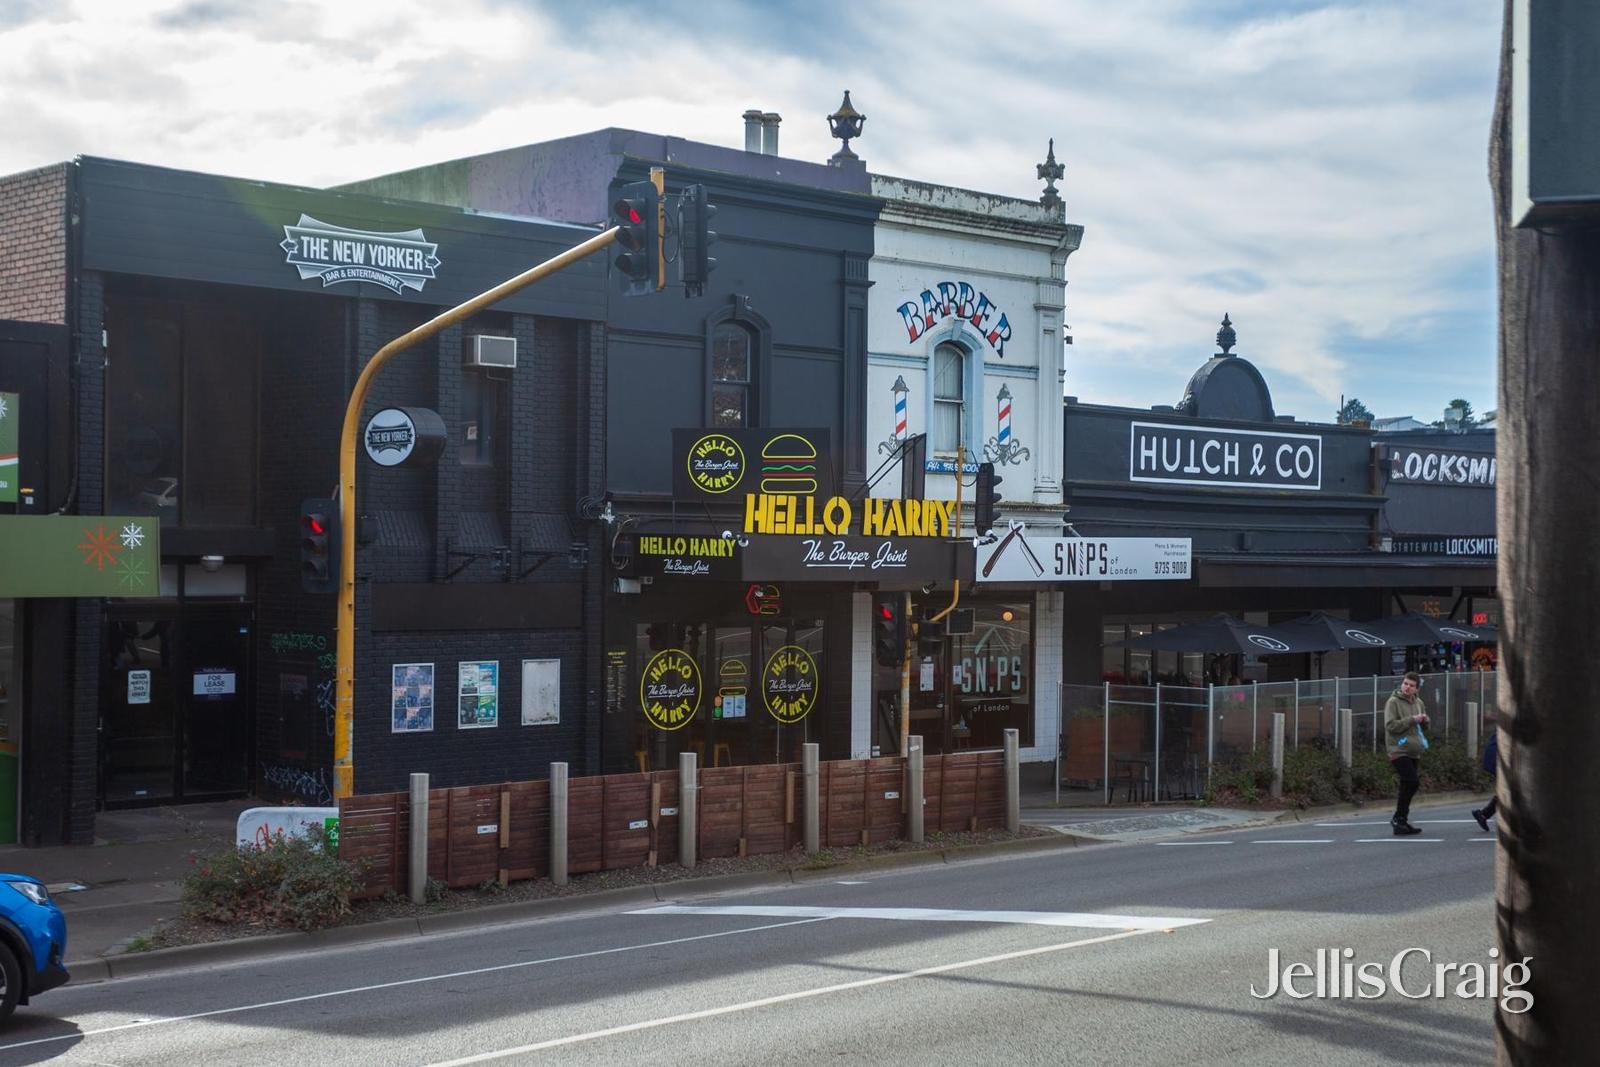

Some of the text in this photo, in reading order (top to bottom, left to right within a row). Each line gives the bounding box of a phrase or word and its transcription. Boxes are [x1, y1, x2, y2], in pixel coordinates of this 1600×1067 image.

[300, 235, 424, 271] THE NEW YORKER
[325, 268, 400, 288] BAR & ENTERTAINMENT
[896, 281, 1012, 359] BARBER
[372, 431, 381, 443] THE
[381, 431, 391, 442] NEW
[696, 439, 736, 458] HELLO
[1140, 435, 1314, 479] HUTCH & CO
[694, 459, 739, 470] The Burger Joint
[697, 470, 735, 488] HARRY
[743, 493, 957, 537] HELLO HARRY
[639, 536, 736, 557] HELLO HARRY
[802, 539, 908, 570] The Burger Joint
[1392, 541, 1444, 553] STATEWIDE
[663, 558, 710, 575] The Burger Joint
[1054, 541, 1119, 576] SNIPS of
[1154, 561, 1170, 574] 9735
[1109, 567, 1138, 575] London
[650, 656, 692, 682] HELLO
[772, 652, 810, 676] HELLO
[204, 680, 225, 688] LEASE
[961, 655, 1021, 694] SNIPS
[647, 684, 658, 696] The
[650, 698, 692, 723] HARRY
[771, 692, 809, 717] HARRY
[973, 704, 1010, 713] of London
